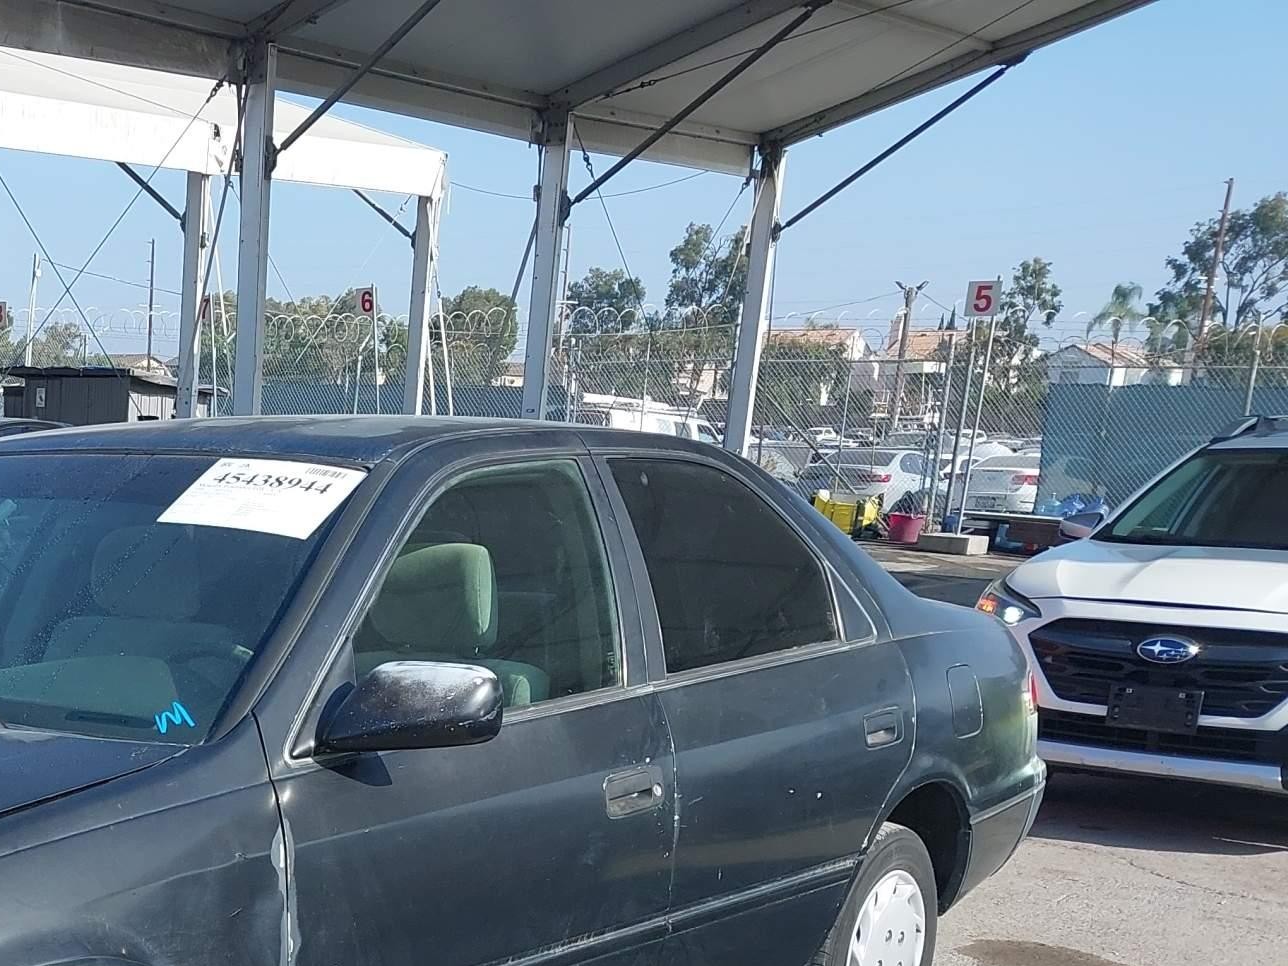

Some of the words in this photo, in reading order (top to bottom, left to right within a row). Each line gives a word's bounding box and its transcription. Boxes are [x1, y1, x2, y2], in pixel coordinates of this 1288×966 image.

[362, 291, 373, 312] 6
[973, 285, 993, 312] 5
[213, 471, 333, 495] 45438944
